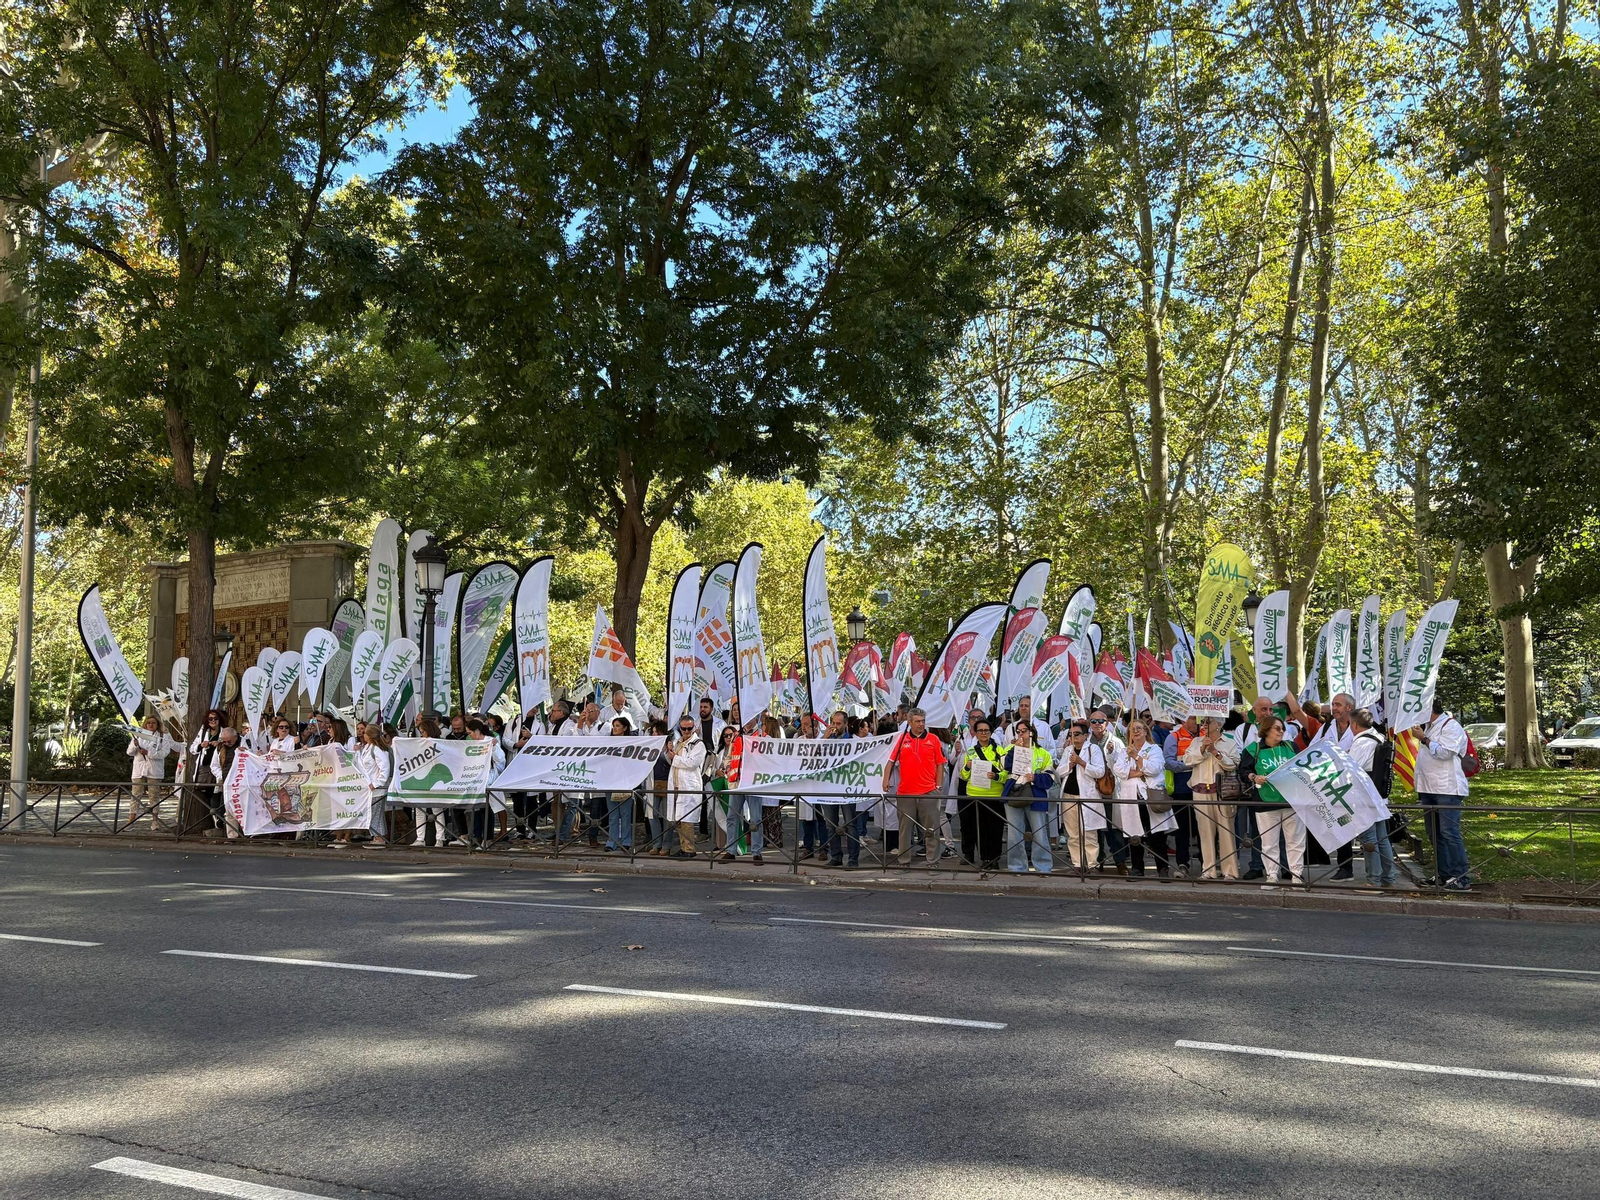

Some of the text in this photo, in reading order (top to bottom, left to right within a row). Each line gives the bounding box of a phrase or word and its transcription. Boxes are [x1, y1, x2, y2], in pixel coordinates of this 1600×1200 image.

[475, 571, 514, 590] SMA
[1208, 557, 1248, 583] SMA
[372, 562, 392, 640] álaga
[1018, 611, 1035, 620] Murcia
[1205, 590, 1224, 627] Sindicato
[1211, 592, 1234, 633] Médico de
[518, 624, 545, 639] SMA
[673, 629, 691, 643] SMA
[736, 619, 755, 635] SMA
[807, 613, 828, 632] SMA
[1219, 604, 1238, 637] Granada
[1263, 608, 1275, 648] Sevilla
[1362, 610, 1372, 648] Sevilla
[957, 635, 976, 646] Murcia
[1333, 621, 1344, 655] Sevilla
[1388, 627, 1399, 660] Sevilla
[1417, 620, 1437, 664] Sevilla
[307, 638, 327, 678] SMA
[353, 642, 378, 679] SMA
[382, 650, 412, 685] SMA
[1260, 645, 1284, 691] SMA
[1331, 654, 1347, 693] SMA
[1359, 646, 1377, 693] SMA
[274, 661, 301, 695] SMA
[1150, 680, 1176, 696] Sindicato
[1188, 688, 1210, 696] ESTATUTO
[1402, 662, 1434, 714] SMA
[248, 676, 264, 714] SMA
[1191, 696, 1228, 705] ROPIO
[398, 743, 441, 776] simex
[751, 740, 774, 755] POR
[778, 741, 795, 756] UN
[797, 740, 851, 757] ESTATUTO
[799, 758, 829, 771] PARA
[551, 759, 596, 777] SMA
[1295, 750, 1355, 816] SMA
[345, 798, 356, 806] DE
[1308, 784, 1324, 803] Médico
[1315, 804, 1334, 829] Sevilla
